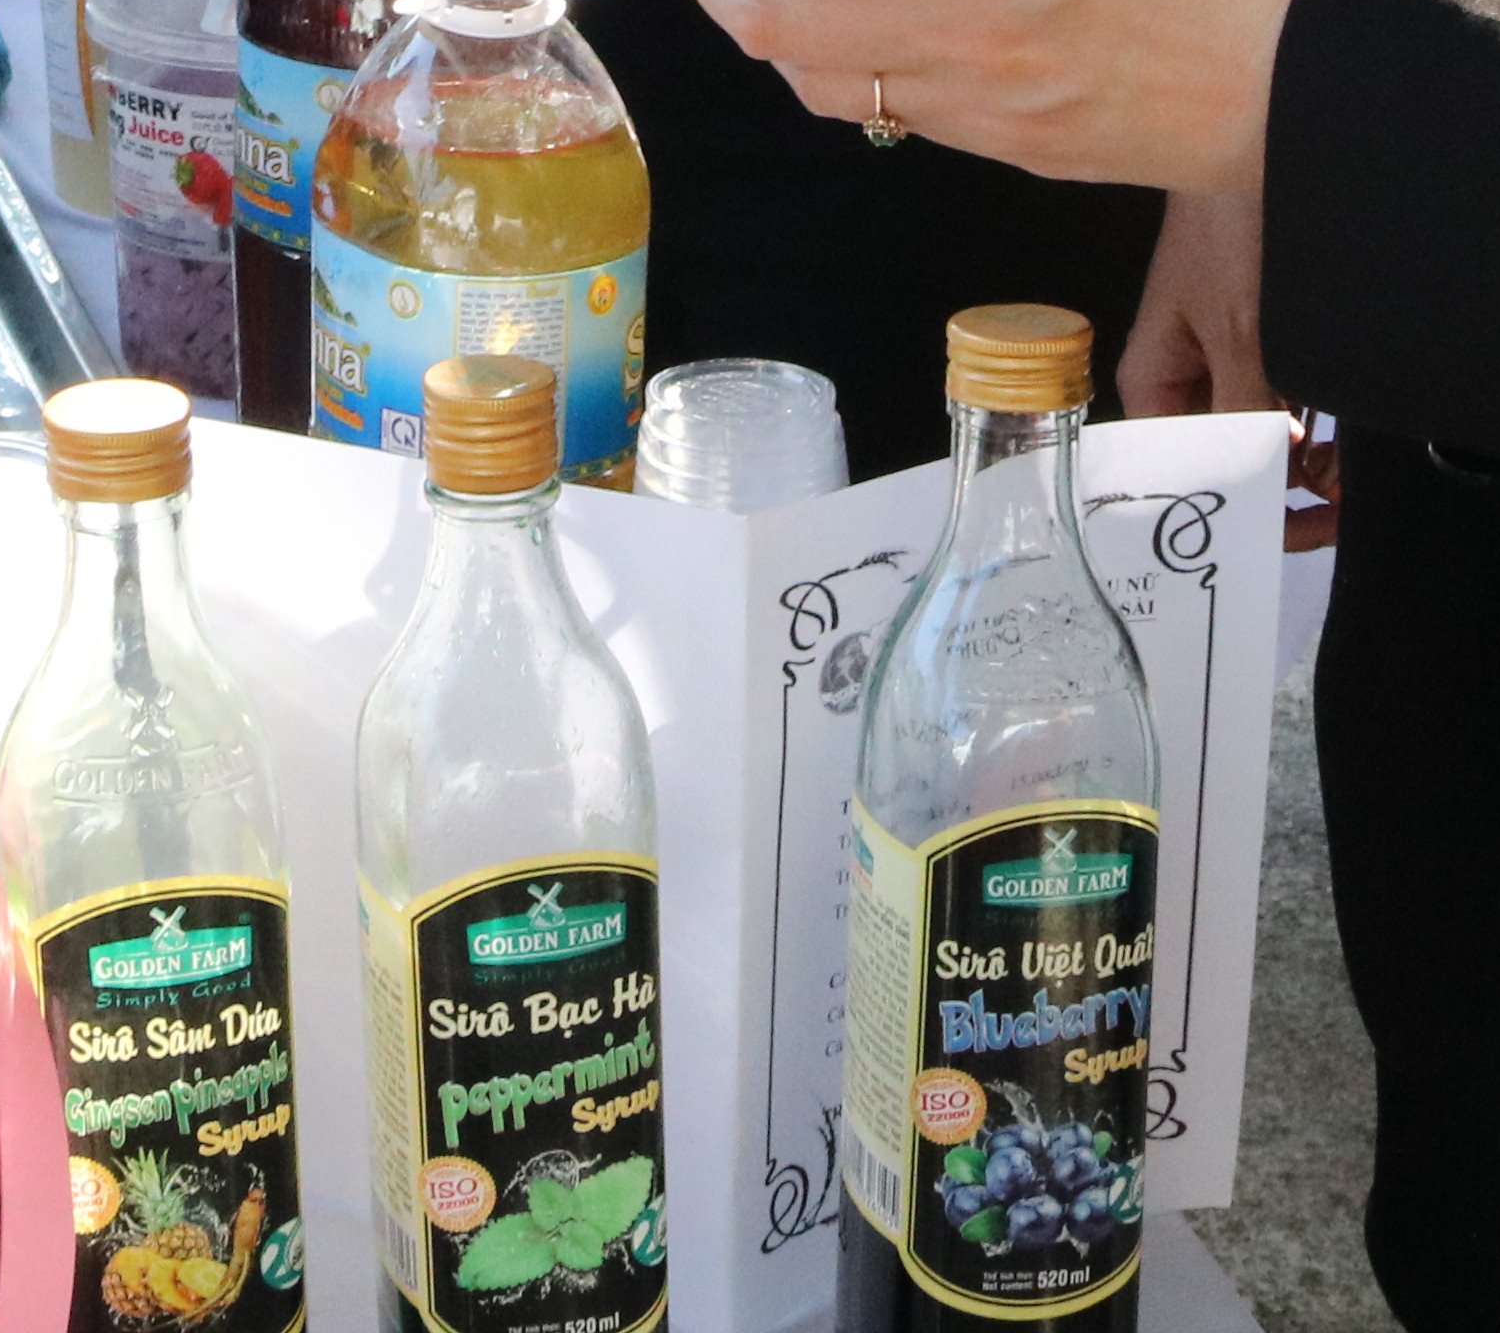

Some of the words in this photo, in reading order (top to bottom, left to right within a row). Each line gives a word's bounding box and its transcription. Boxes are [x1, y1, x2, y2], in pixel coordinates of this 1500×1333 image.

[128, 117, 184, 146] Juice
[987, 875, 1069, 898] GOLDEN
[1077, 864, 1129, 893] FARM
[473, 932, 559, 956] GOLDEN
[568, 912, 624, 946] FARM
[94, 954, 182, 981] GOLDEN
[191, 937, 247, 968] FARM
[935, 939, 1009, 981] Sirô
[1020, 939, 1086, 989] Việt
[96, 988, 180, 1010] Simply
[192, 972, 251, 999] Good
[428, 997, 515, 1040] Sirô
[522, 991, 603, 1039] Bạc
[612, 970, 657, 1020] Hà
[68, 1021, 139, 1064] Sirô
[146, 1015, 216, 1060] Sâm
[219, 1000, 282, 1047] Dứa
[939, 983, 1150, 1055] Blueberry
[437, 1016, 657, 1150] peppermint
[1063, 1038, 1149, 1085] Syrup
[65, 1086, 173, 1149] Gingsen
[169, 1040, 289, 1136] pineapple
[572, 1079, 661, 1133] Syrup
[920, 1090, 970, 1113] ISO
[197, 1103, 291, 1156] Syrup
[429, 1177, 478, 1200] ISO
